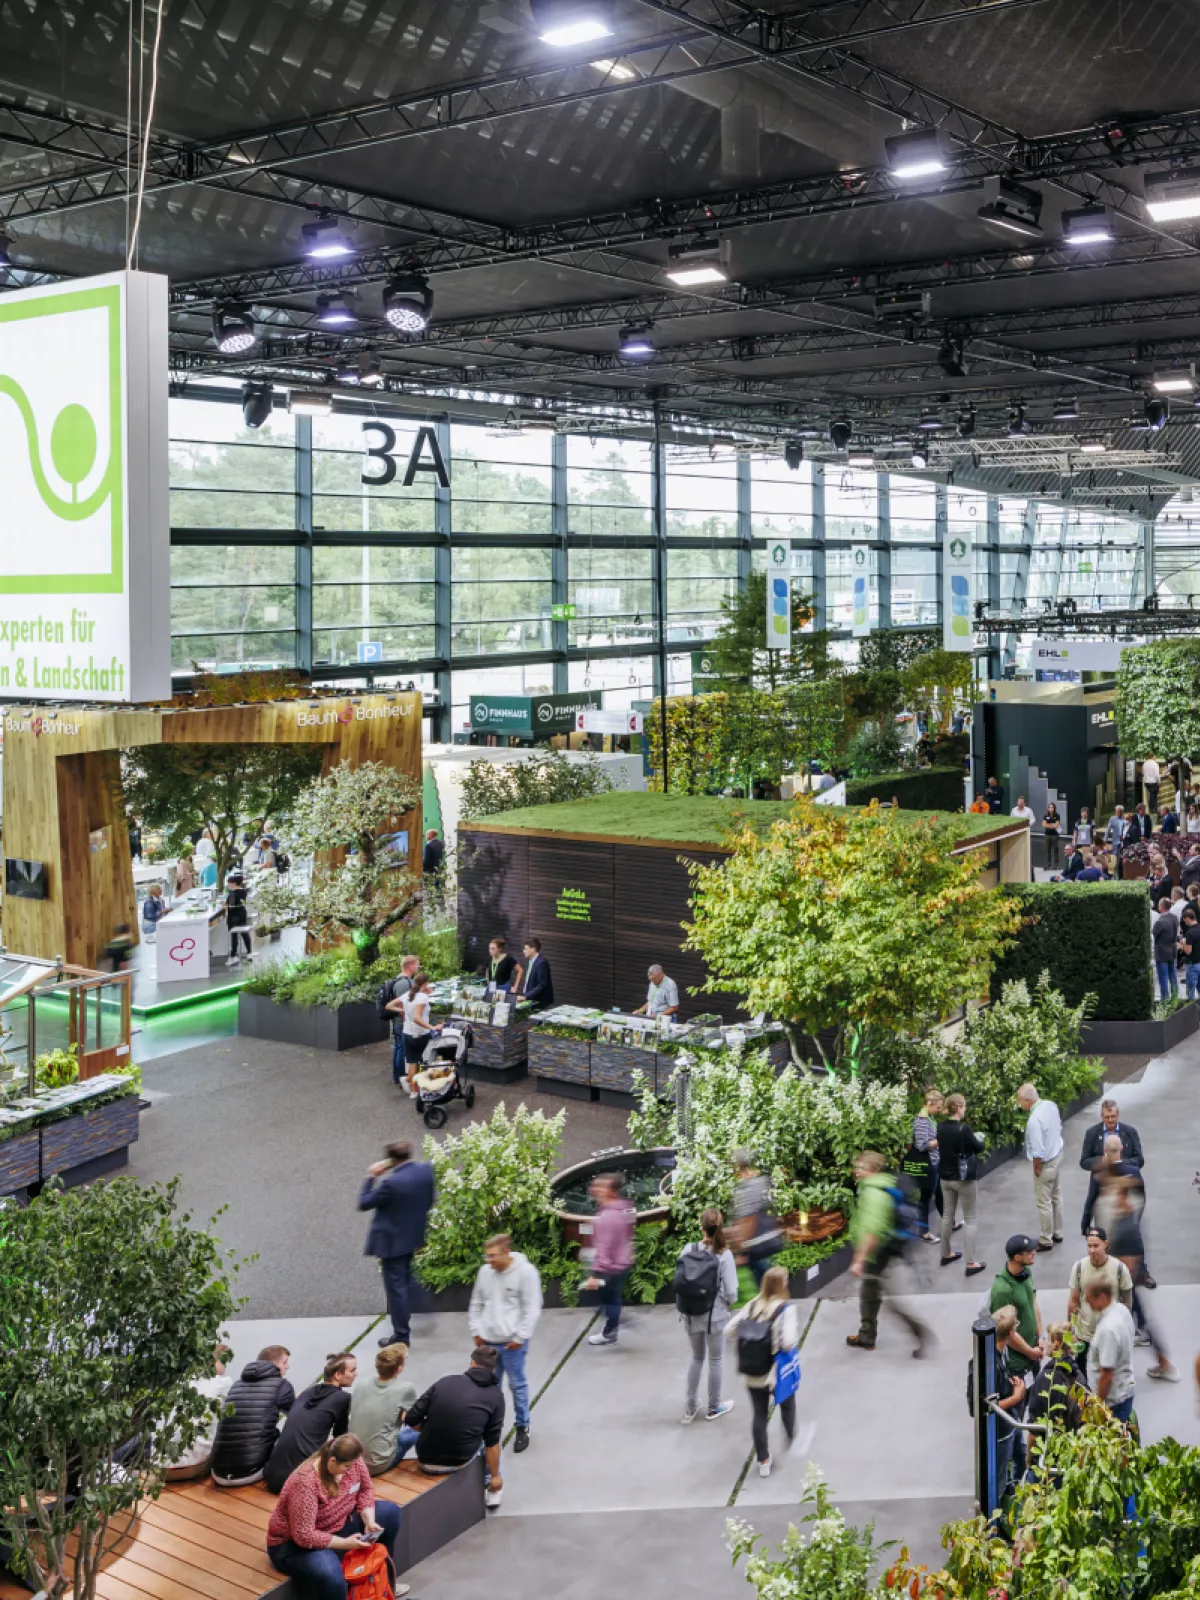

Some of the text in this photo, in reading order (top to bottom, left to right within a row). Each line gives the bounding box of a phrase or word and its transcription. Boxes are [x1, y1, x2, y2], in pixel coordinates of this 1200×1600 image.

[361, 421, 451, 488] 3A
[0, 607, 95, 652] xperten für
[363, 645, 377, 663] P
[1038, 649, 1061, 658] EHL
[15, 657, 27, 688] &
[33, 655, 125, 692] Landschaft
[297, 703, 414, 727] Baum Bonheur
[489, 708, 528, 719] FINNHAUS
[1091, 711, 1108, 724] EHL
